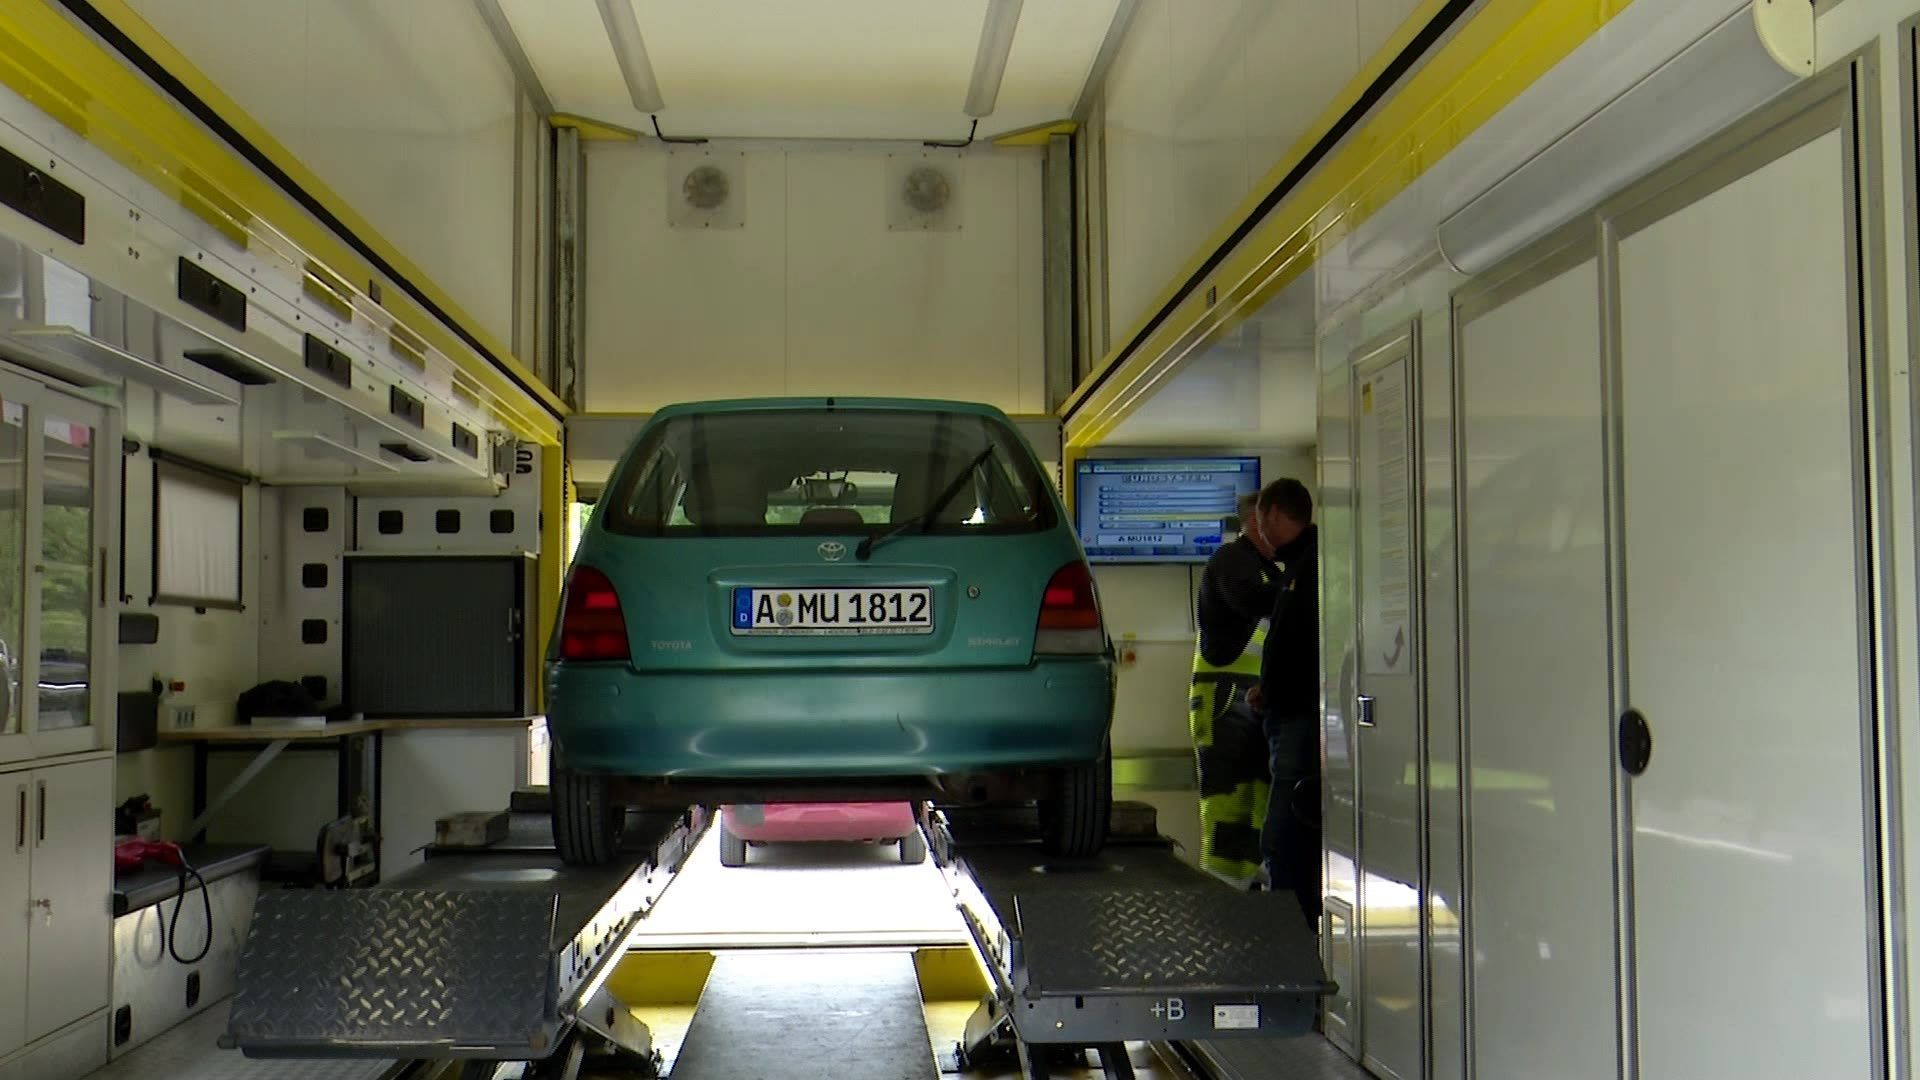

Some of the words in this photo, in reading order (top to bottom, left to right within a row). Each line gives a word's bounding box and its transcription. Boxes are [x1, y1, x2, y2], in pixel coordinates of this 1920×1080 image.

[756, 593, 775, 624] A
[798, 592, 839, 624] MU
[848, 592, 927, 623] 1812
[739, 613, 748, 622] D
[651, 640, 692, 649] TOYOTA
